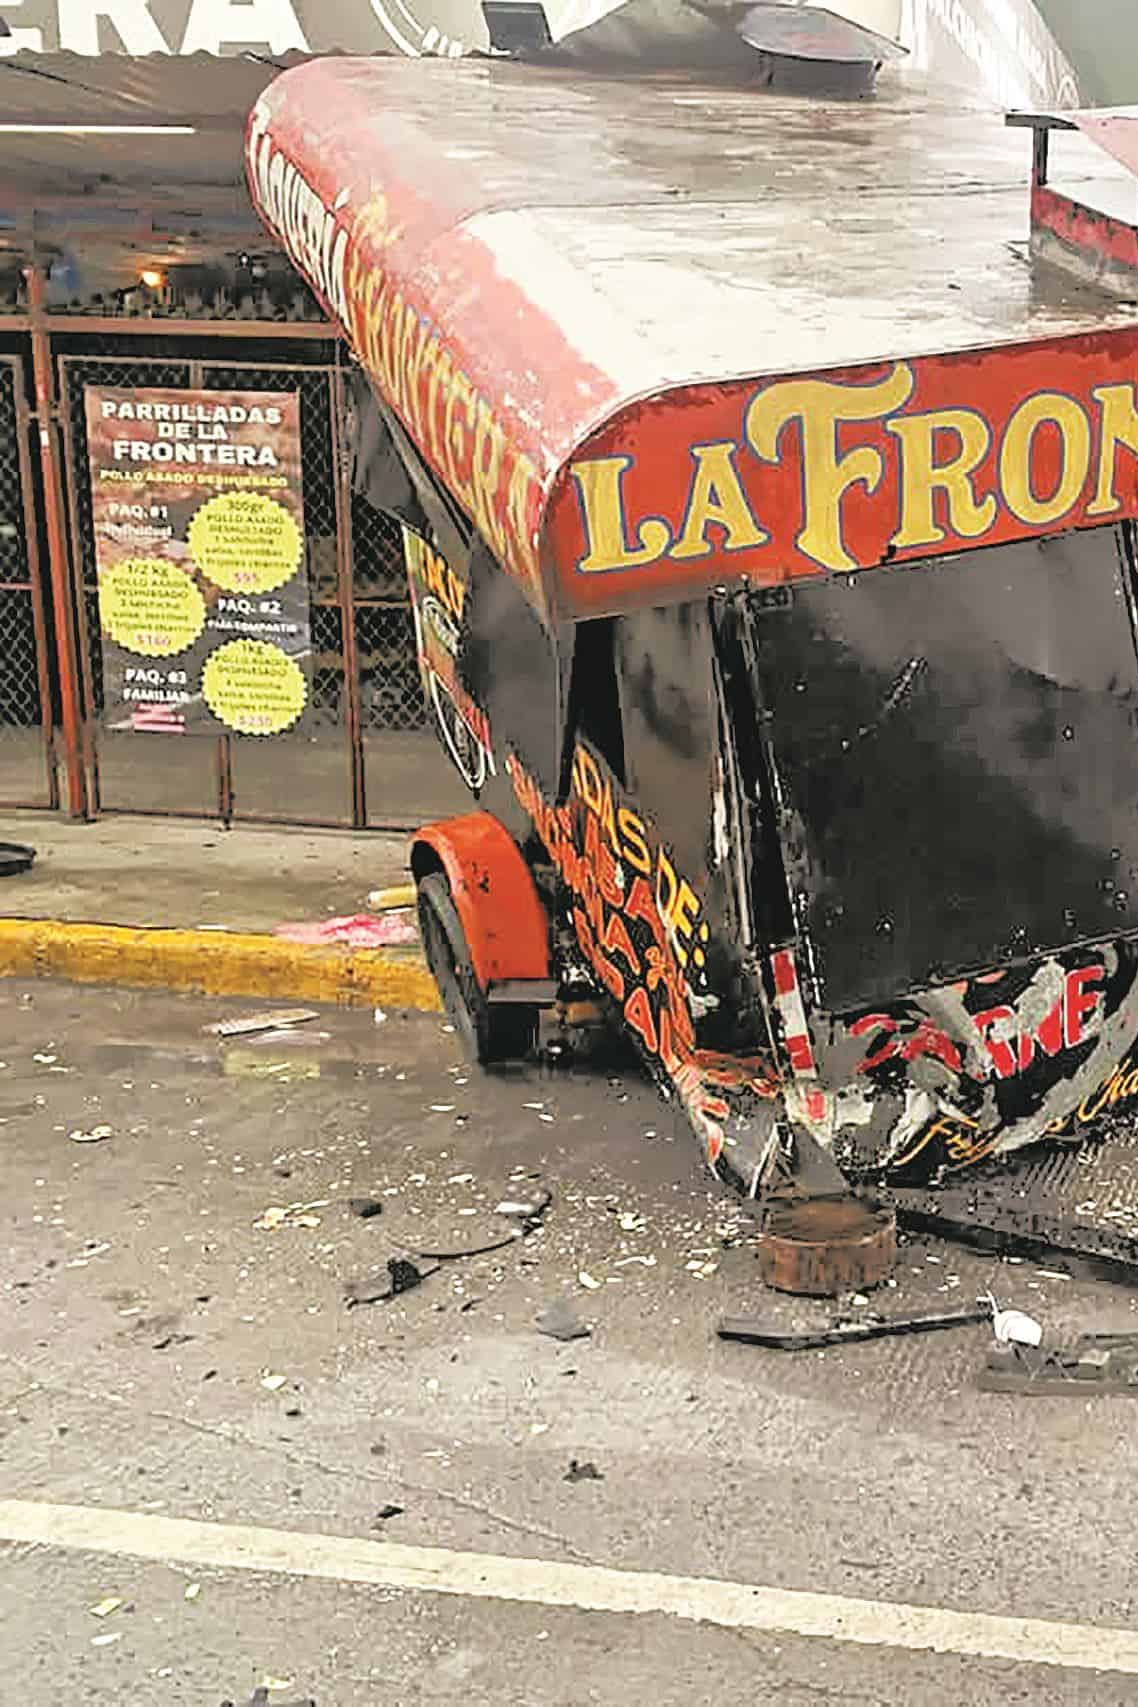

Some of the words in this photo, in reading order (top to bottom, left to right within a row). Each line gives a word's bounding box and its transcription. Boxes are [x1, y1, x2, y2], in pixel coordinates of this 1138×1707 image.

[101, 401, 282, 425] PARRILLADAS
[158, 423, 193, 439] DE
[196, 423, 228, 441] LA
[113, 440, 278, 467] FRONTERA
[100, 470, 145, 482] POLLO
[147, 472, 194, 484] ASADO
[109, 503, 149, 519] PAQ.
[570, 440, 770, 574] LA
[218, 599, 256, 616] PAQ.
[125, 668, 166, 685] PAQ.
[123, 688, 190, 703] FAMILIAR
